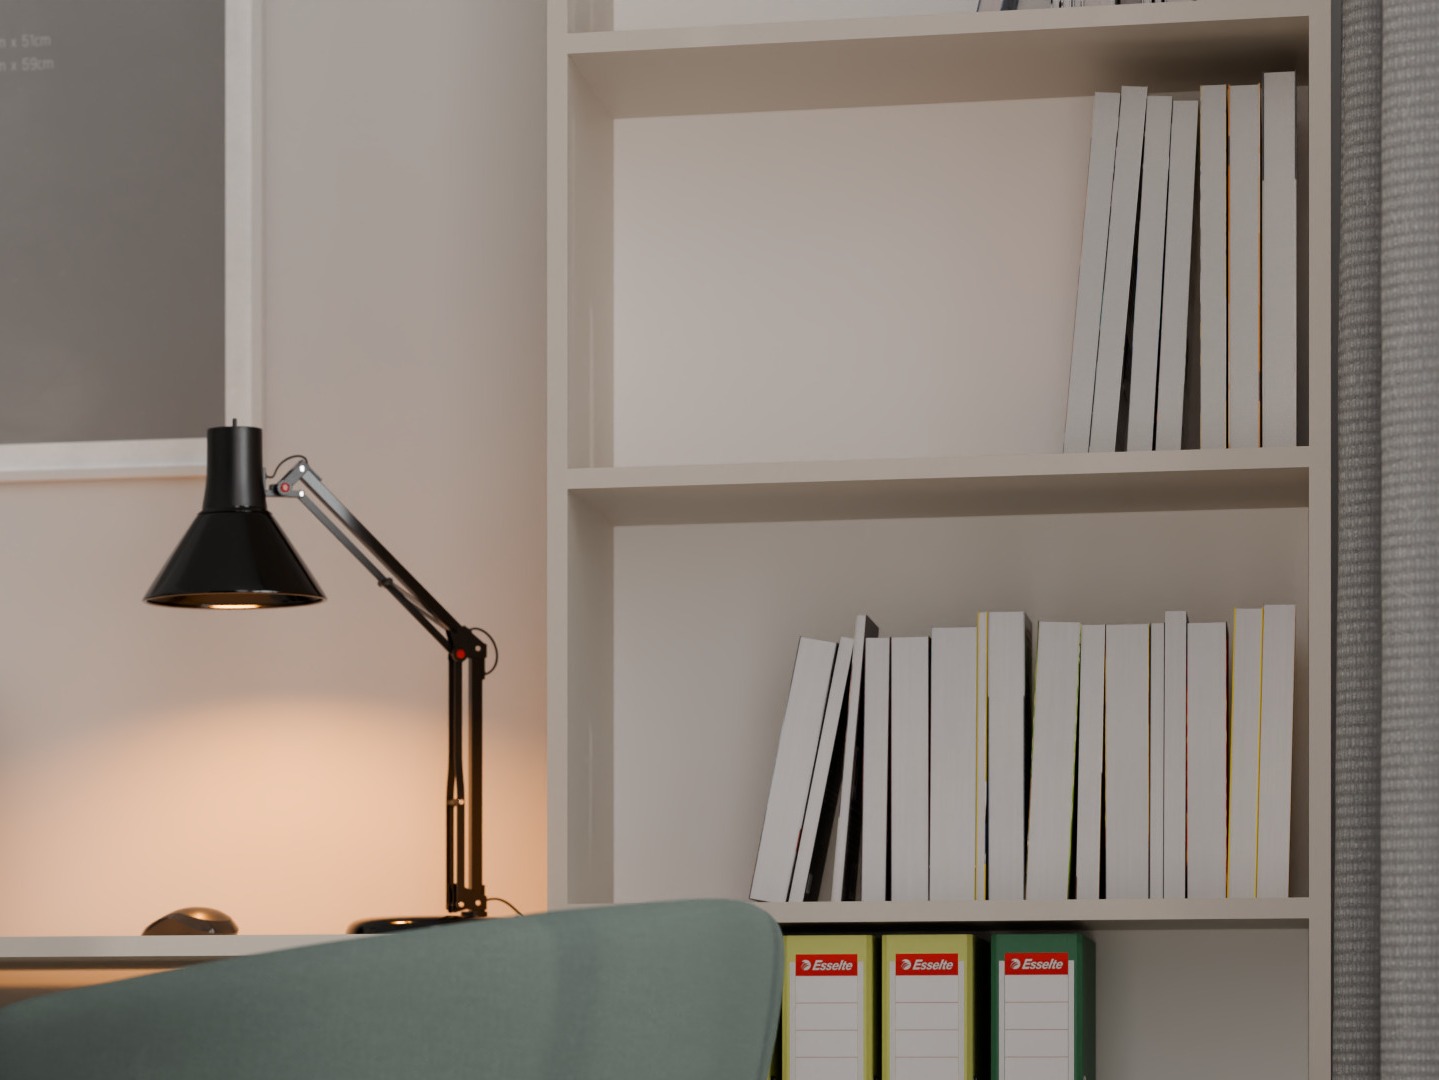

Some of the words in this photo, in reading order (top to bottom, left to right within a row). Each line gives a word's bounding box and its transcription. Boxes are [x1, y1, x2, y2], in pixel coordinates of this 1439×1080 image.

[10, 38, 17, 48] x
[21, 33, 52, 48] 51cm
[10, 61, 17, 71] x
[812, 959, 853, 971] Esselte
[912, 959, 954, 971] Esselte
[1022, 958, 1064, 970] Esselte
